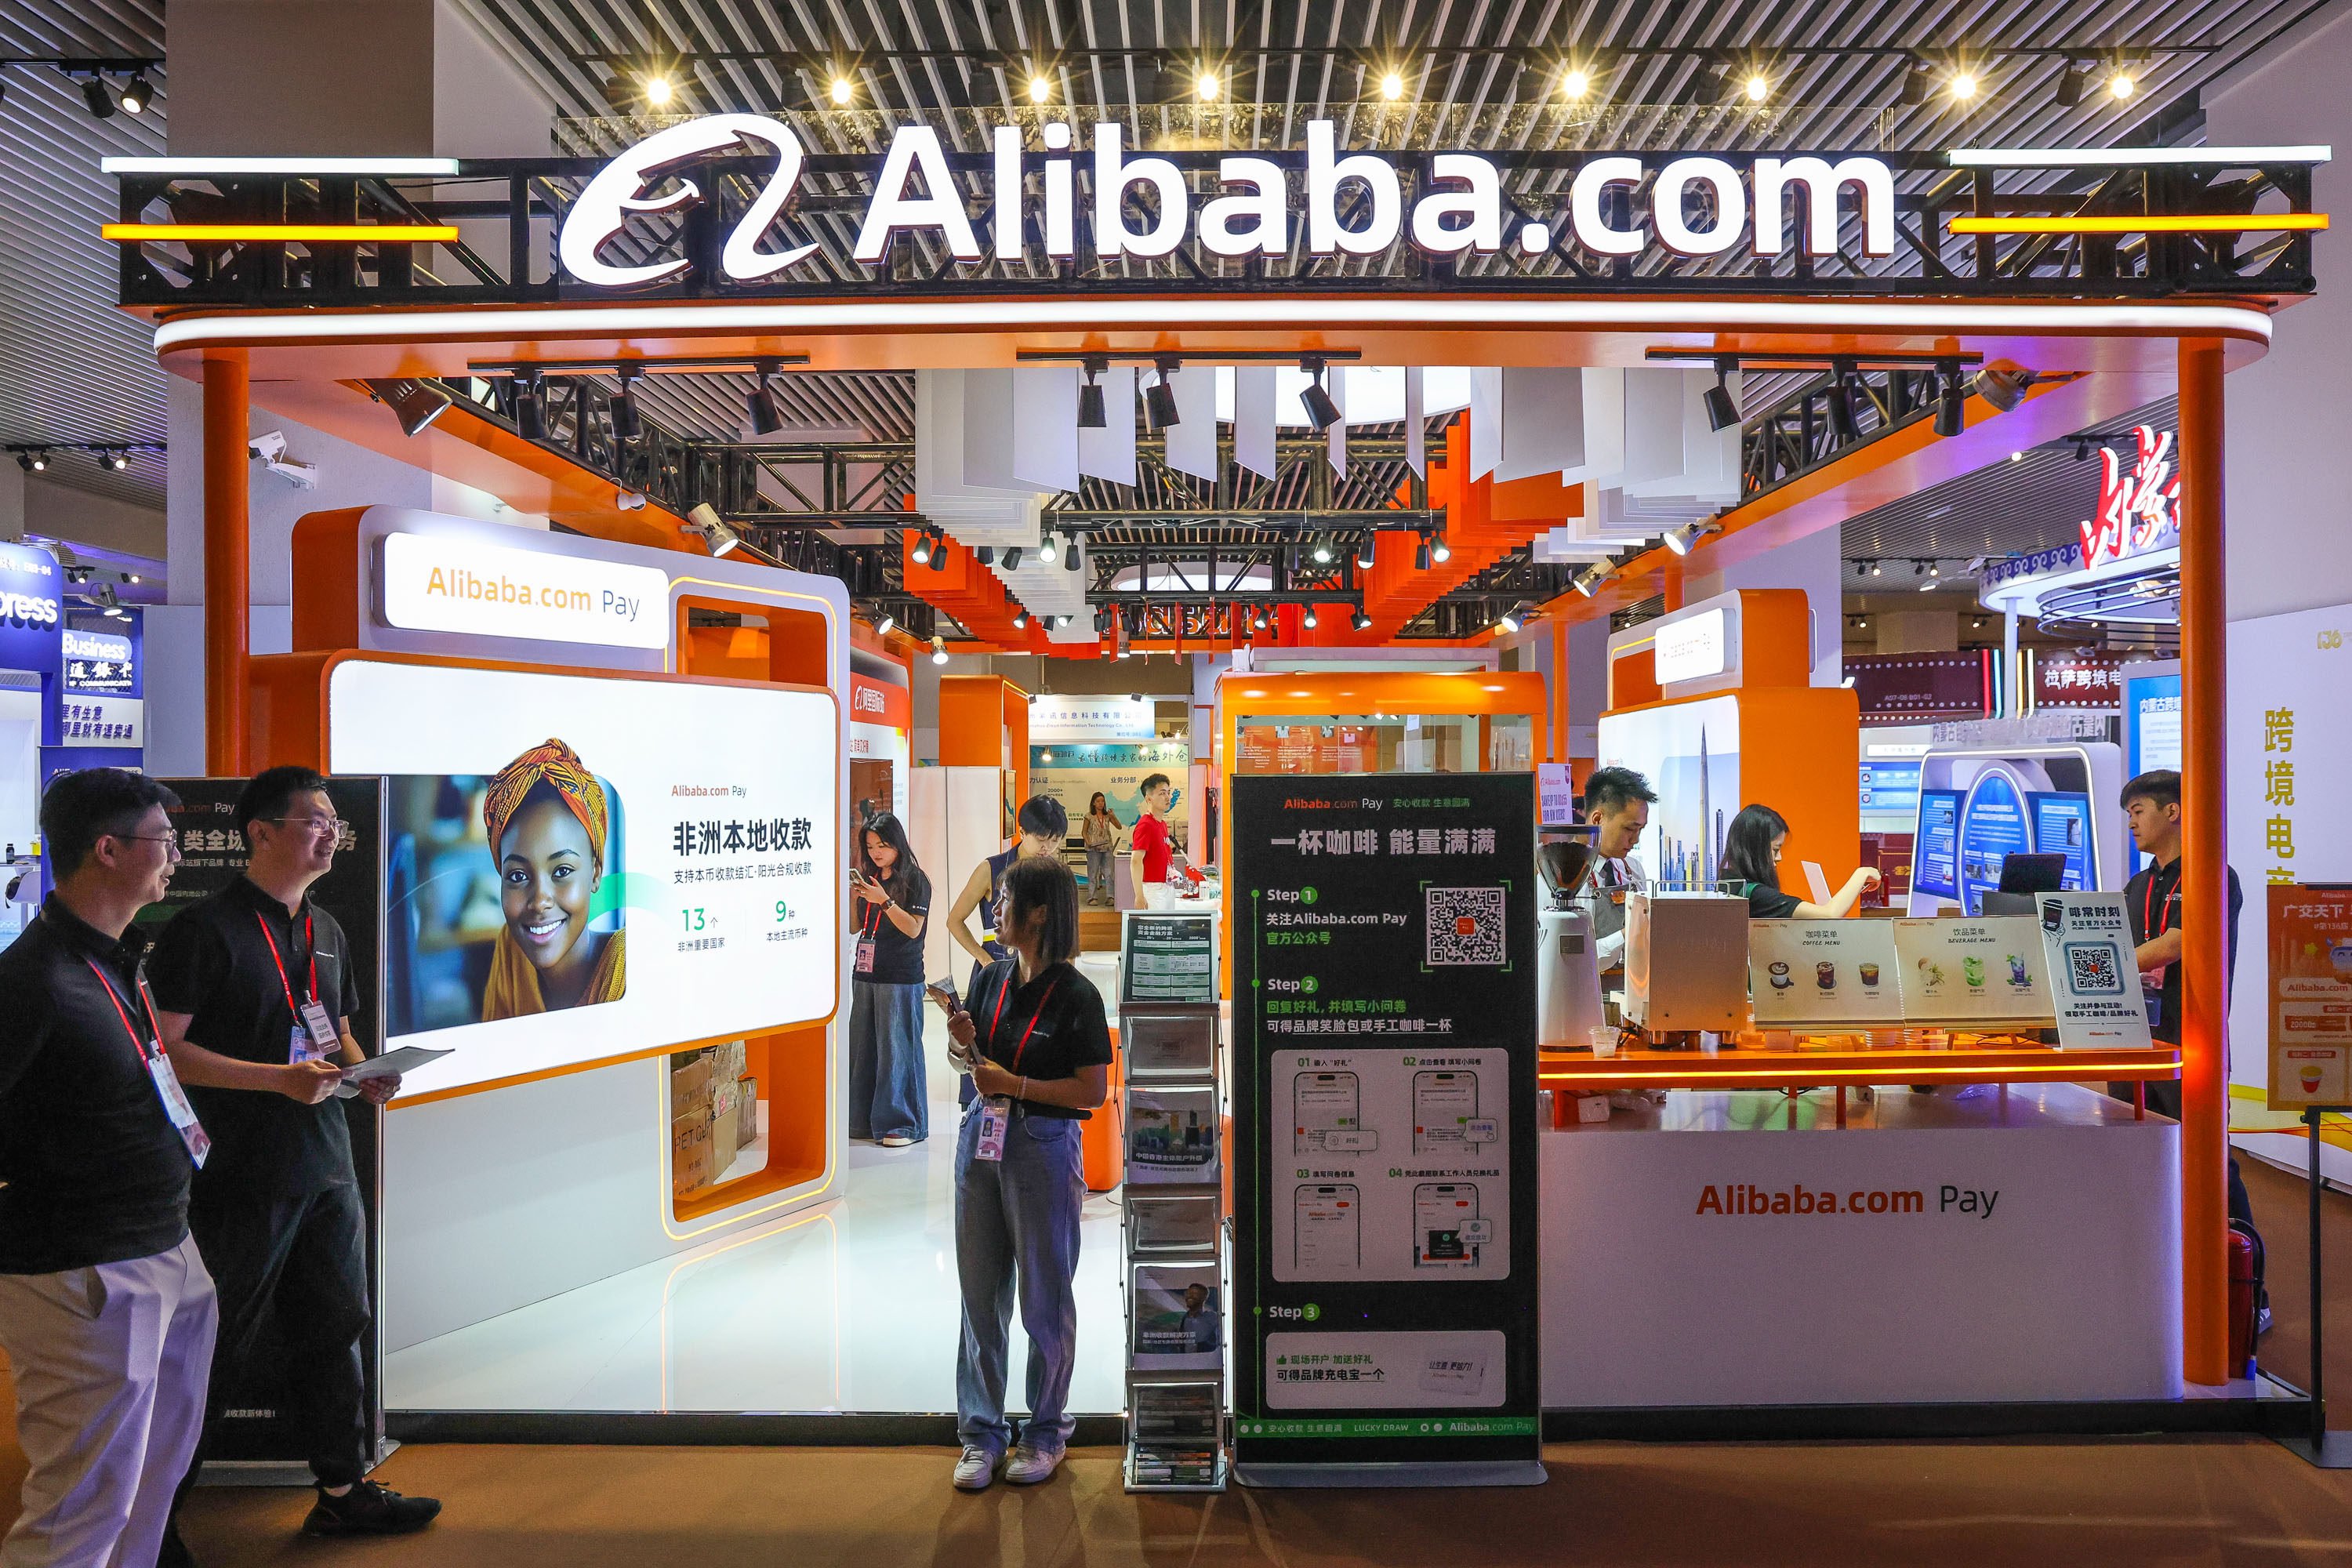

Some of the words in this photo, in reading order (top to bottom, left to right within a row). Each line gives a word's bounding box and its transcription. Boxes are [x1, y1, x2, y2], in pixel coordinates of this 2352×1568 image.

[853, 120, 1894, 261] Alibaba.com
[426, 566, 593, 612] Alibaba.com
[602, 590, 641, 622] Pay
[63, 633, 126, 660] Business
[671, 785, 729, 798] Alibaba.com
[731, 786, 747, 800] Pay
[215, 802, 235, 815] Pay
[1283, 798, 1358, 809] Alibaba.com
[1362, 798, 1383, 811] Pay
[673, 816, 812, 856] 非洲本地收款
[1271, 829, 1379, 855] 一杯咖啡
[1389, 828, 1496, 855] 能量满满
[1267, 889, 1300, 903] Step
[682, 907, 706, 931] 13
[775, 900, 787, 923] 9
[789, 909, 795, 920] 种
[2069, 906, 2121, 918] 啡常时刻
[2283, 904, 2344, 918] 广交天下
[1267, 912, 1378, 927] 关注Alibaba.com
[1382, 913, 1406, 927] Pay
[766, 927, 808, 942] 本地主流币种
[1267, 932, 1331, 946] 官方公众号
[1805, 930, 1838, 939] 咖啡菜单
[1953, 927, 1986, 936] 饮品菜单
[677, 936, 726, 953] 非洲重要国家
[1267, 978, 1300, 993] Step
[1267, 1018, 1452, 1033] 可得品牌笑脸包或手工咖啡一杯
[1298, 1058, 1310, 1067] 01
[1403, 1057, 1416, 1066] 02
[1297, 1169, 1309, 1178] 03
[1388, 1168, 1403, 1178] 04
[1696, 1184, 1924, 1215] Alibaba.com
[1940, 1185, 1999, 1219] Pay
[1269, 1305, 1301, 1320] Step
[1290, 1355, 1329, 1365] 现场开户
[1333, 1354, 1373, 1365] 加送好礼
[1276, 1368, 1385, 1381] 可得品牌充电宝一个
[1268, 1423, 1303, 1434] 安心收款
[1306, 1423, 1341, 1433] 生意圆满
[1354, 1423, 1381, 1432] LUCKY
[1383, 1423, 1409, 1432] DRAW
[1449, 1421, 1512, 1432] Alibaba.com
[1516, 1421, 1535, 1434] Pay
